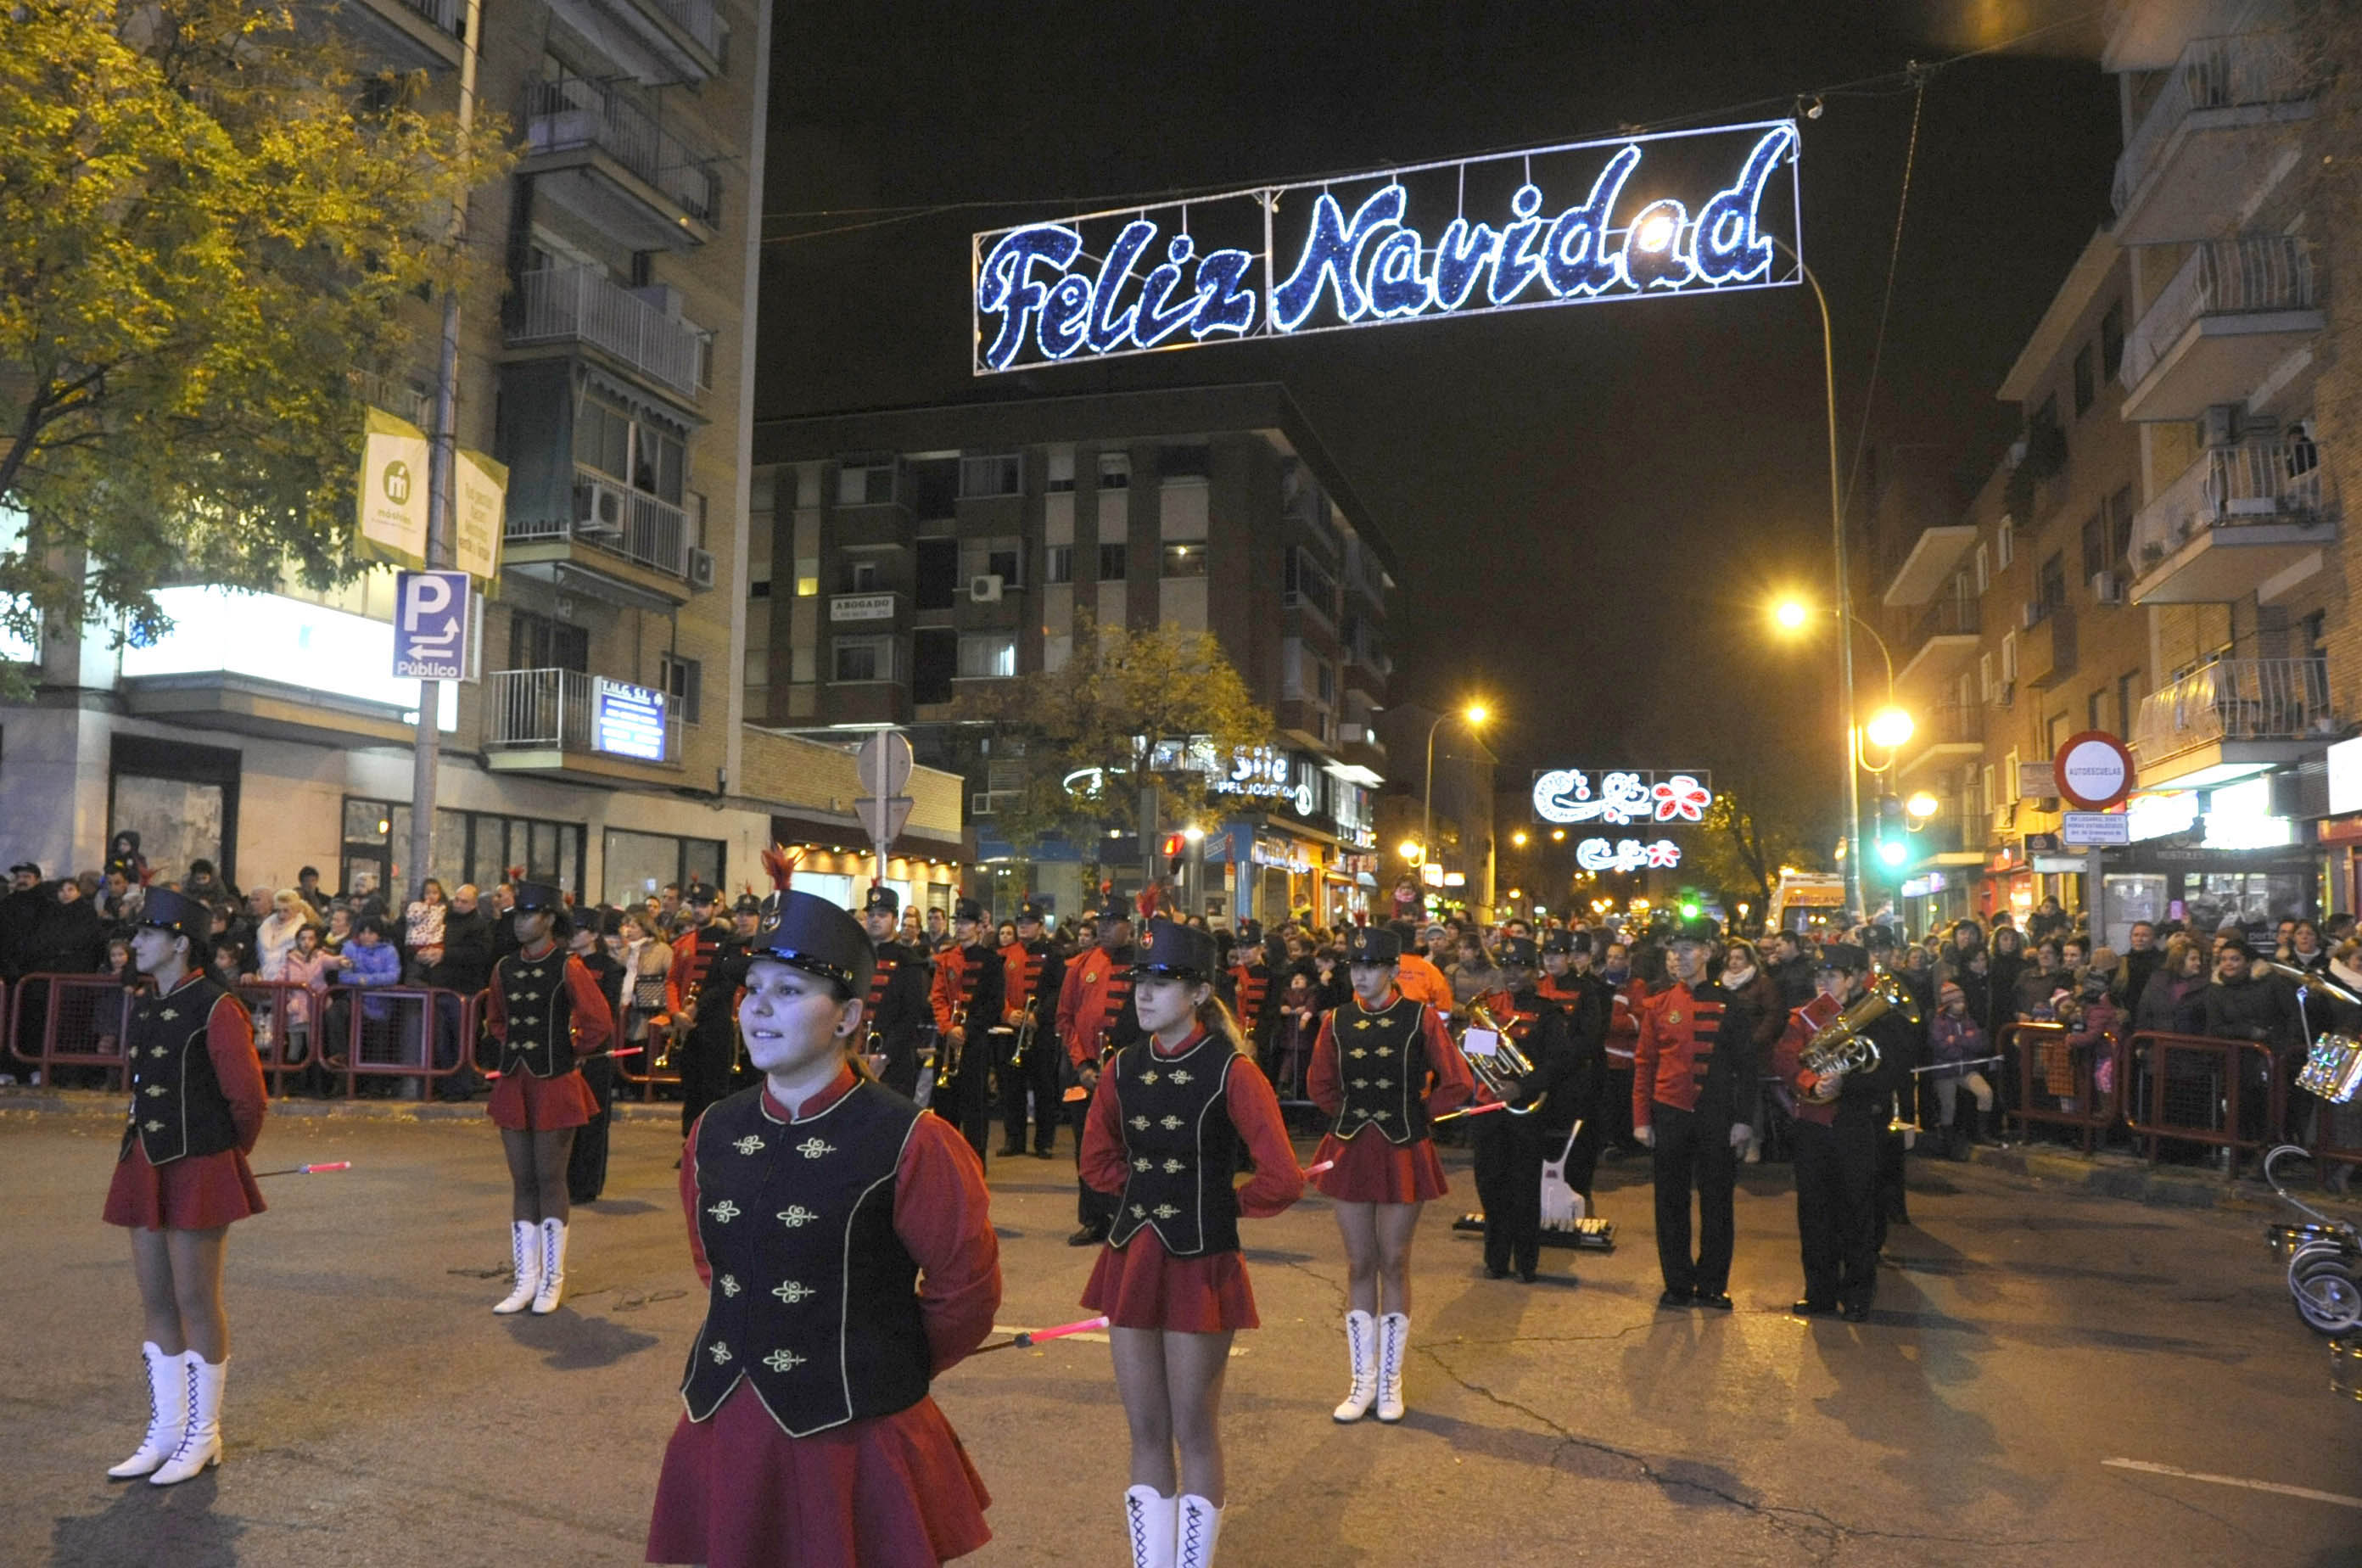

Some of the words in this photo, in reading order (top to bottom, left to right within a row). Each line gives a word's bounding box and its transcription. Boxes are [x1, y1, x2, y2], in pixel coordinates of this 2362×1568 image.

[978, 221, 1254, 372] Feliz
[1273, 125, 1799, 335] Navidad
[404, 574, 452, 631] P
[835, 599, 889, 610] ABOGADO
[397, 661, 457, 677] Público
[2069, 766, 2122, 776] AUTOESCUELAS
